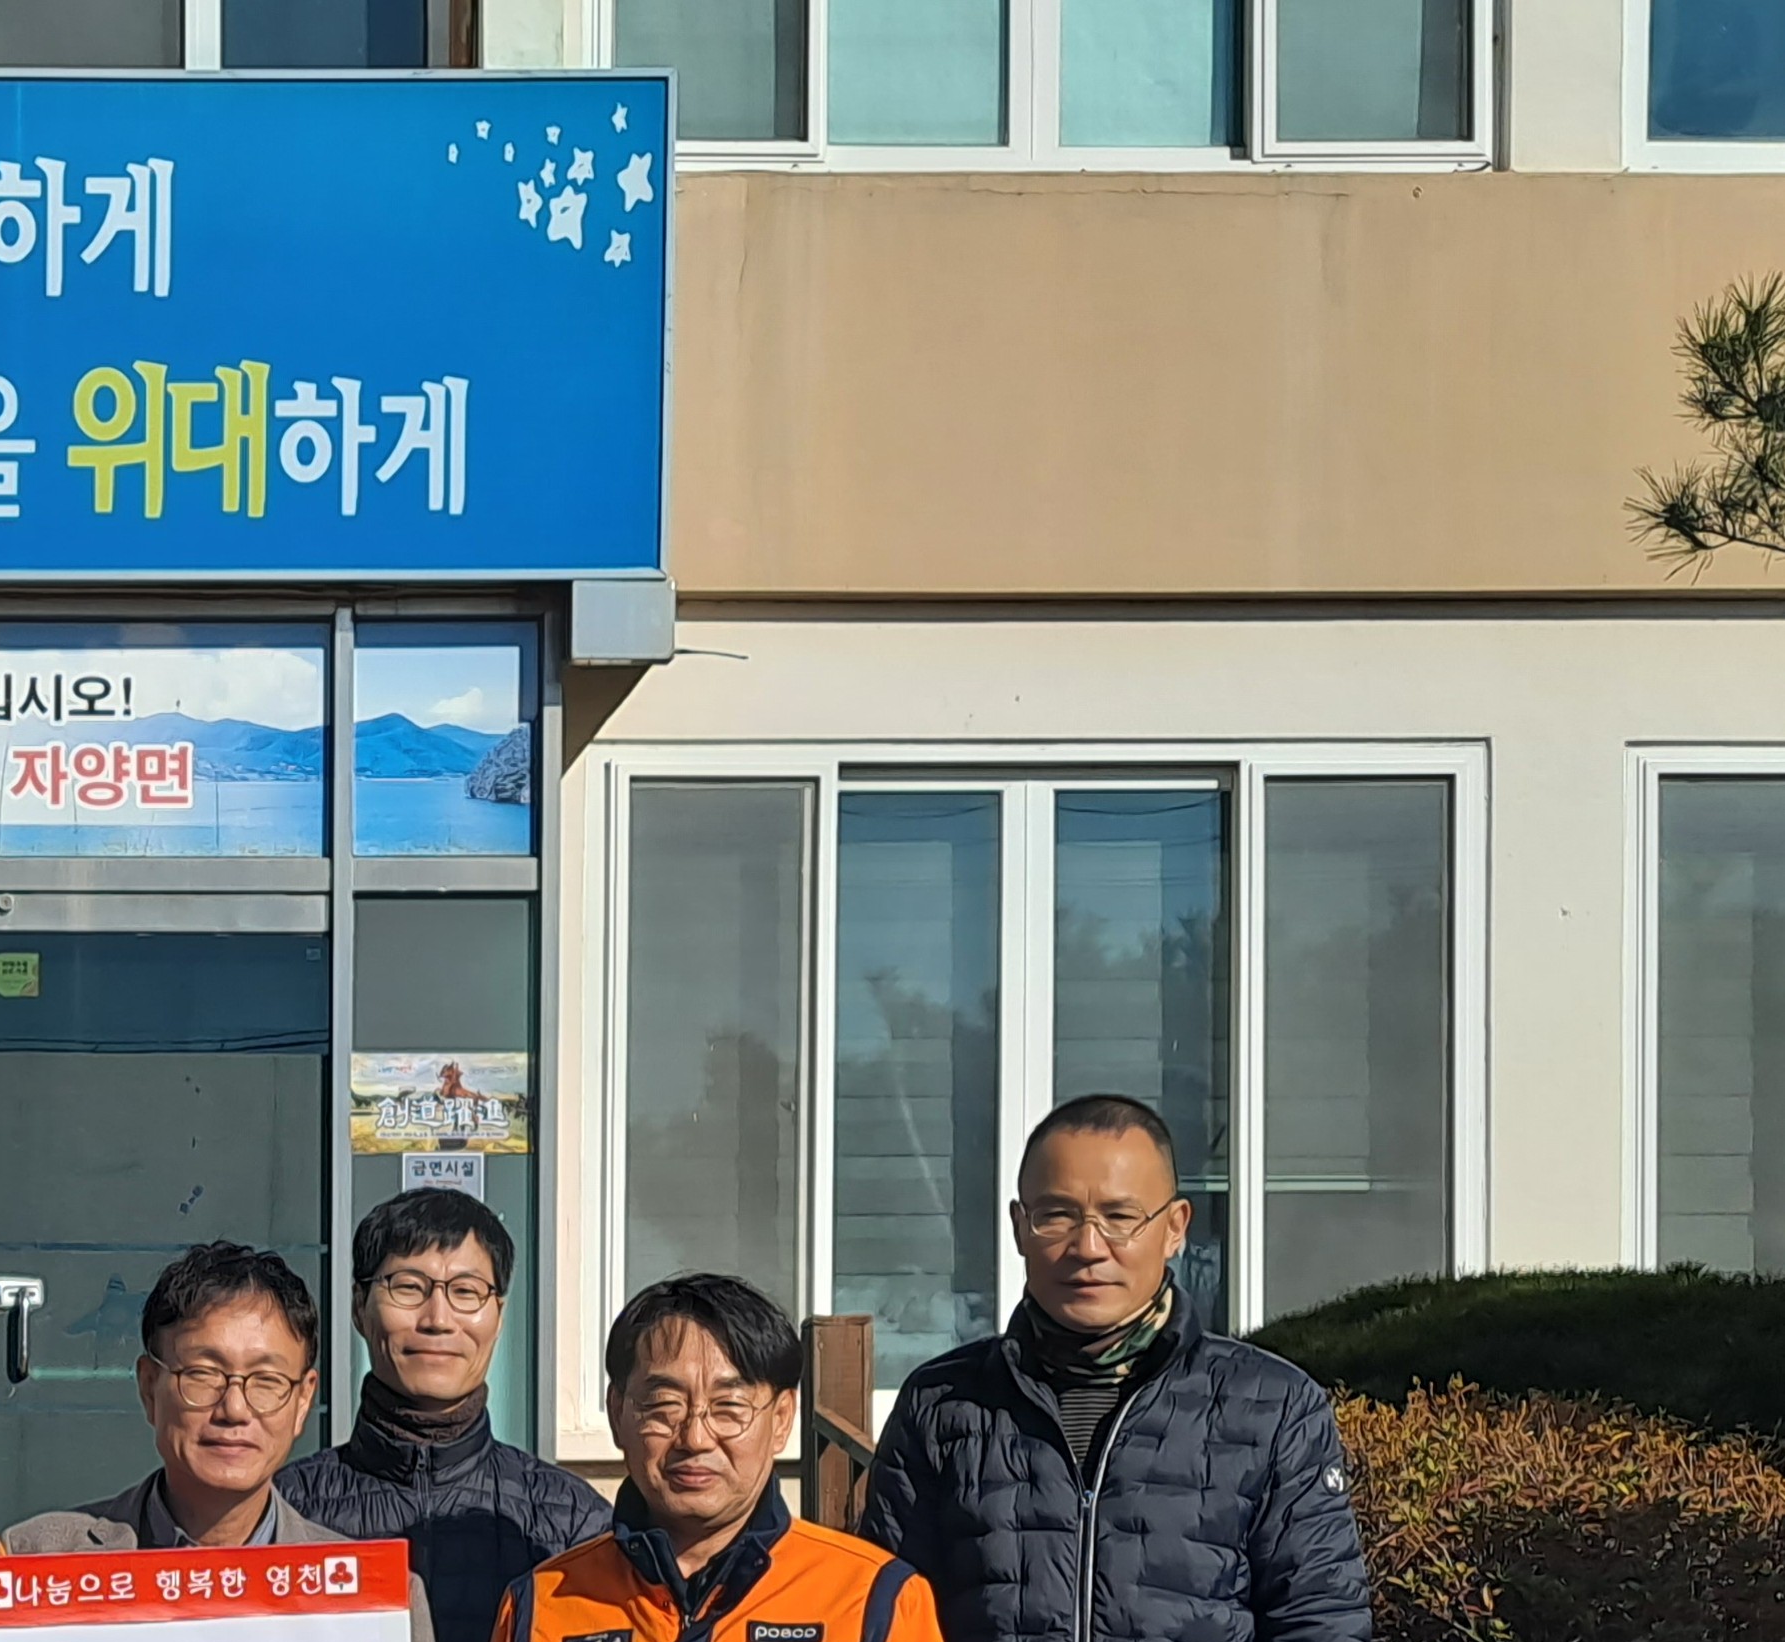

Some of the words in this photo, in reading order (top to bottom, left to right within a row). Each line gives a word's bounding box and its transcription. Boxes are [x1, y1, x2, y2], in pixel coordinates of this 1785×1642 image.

[67, 358, 470, 518] 위대하게
[11, 745, 191, 806] 자양면
[411, 1159, 474, 1178] 금연시설
[14, 1570, 137, 1609] 나눔으로
[155, 1566, 248, 1600] 행복한
[265, 1563, 325, 1596] 영천
